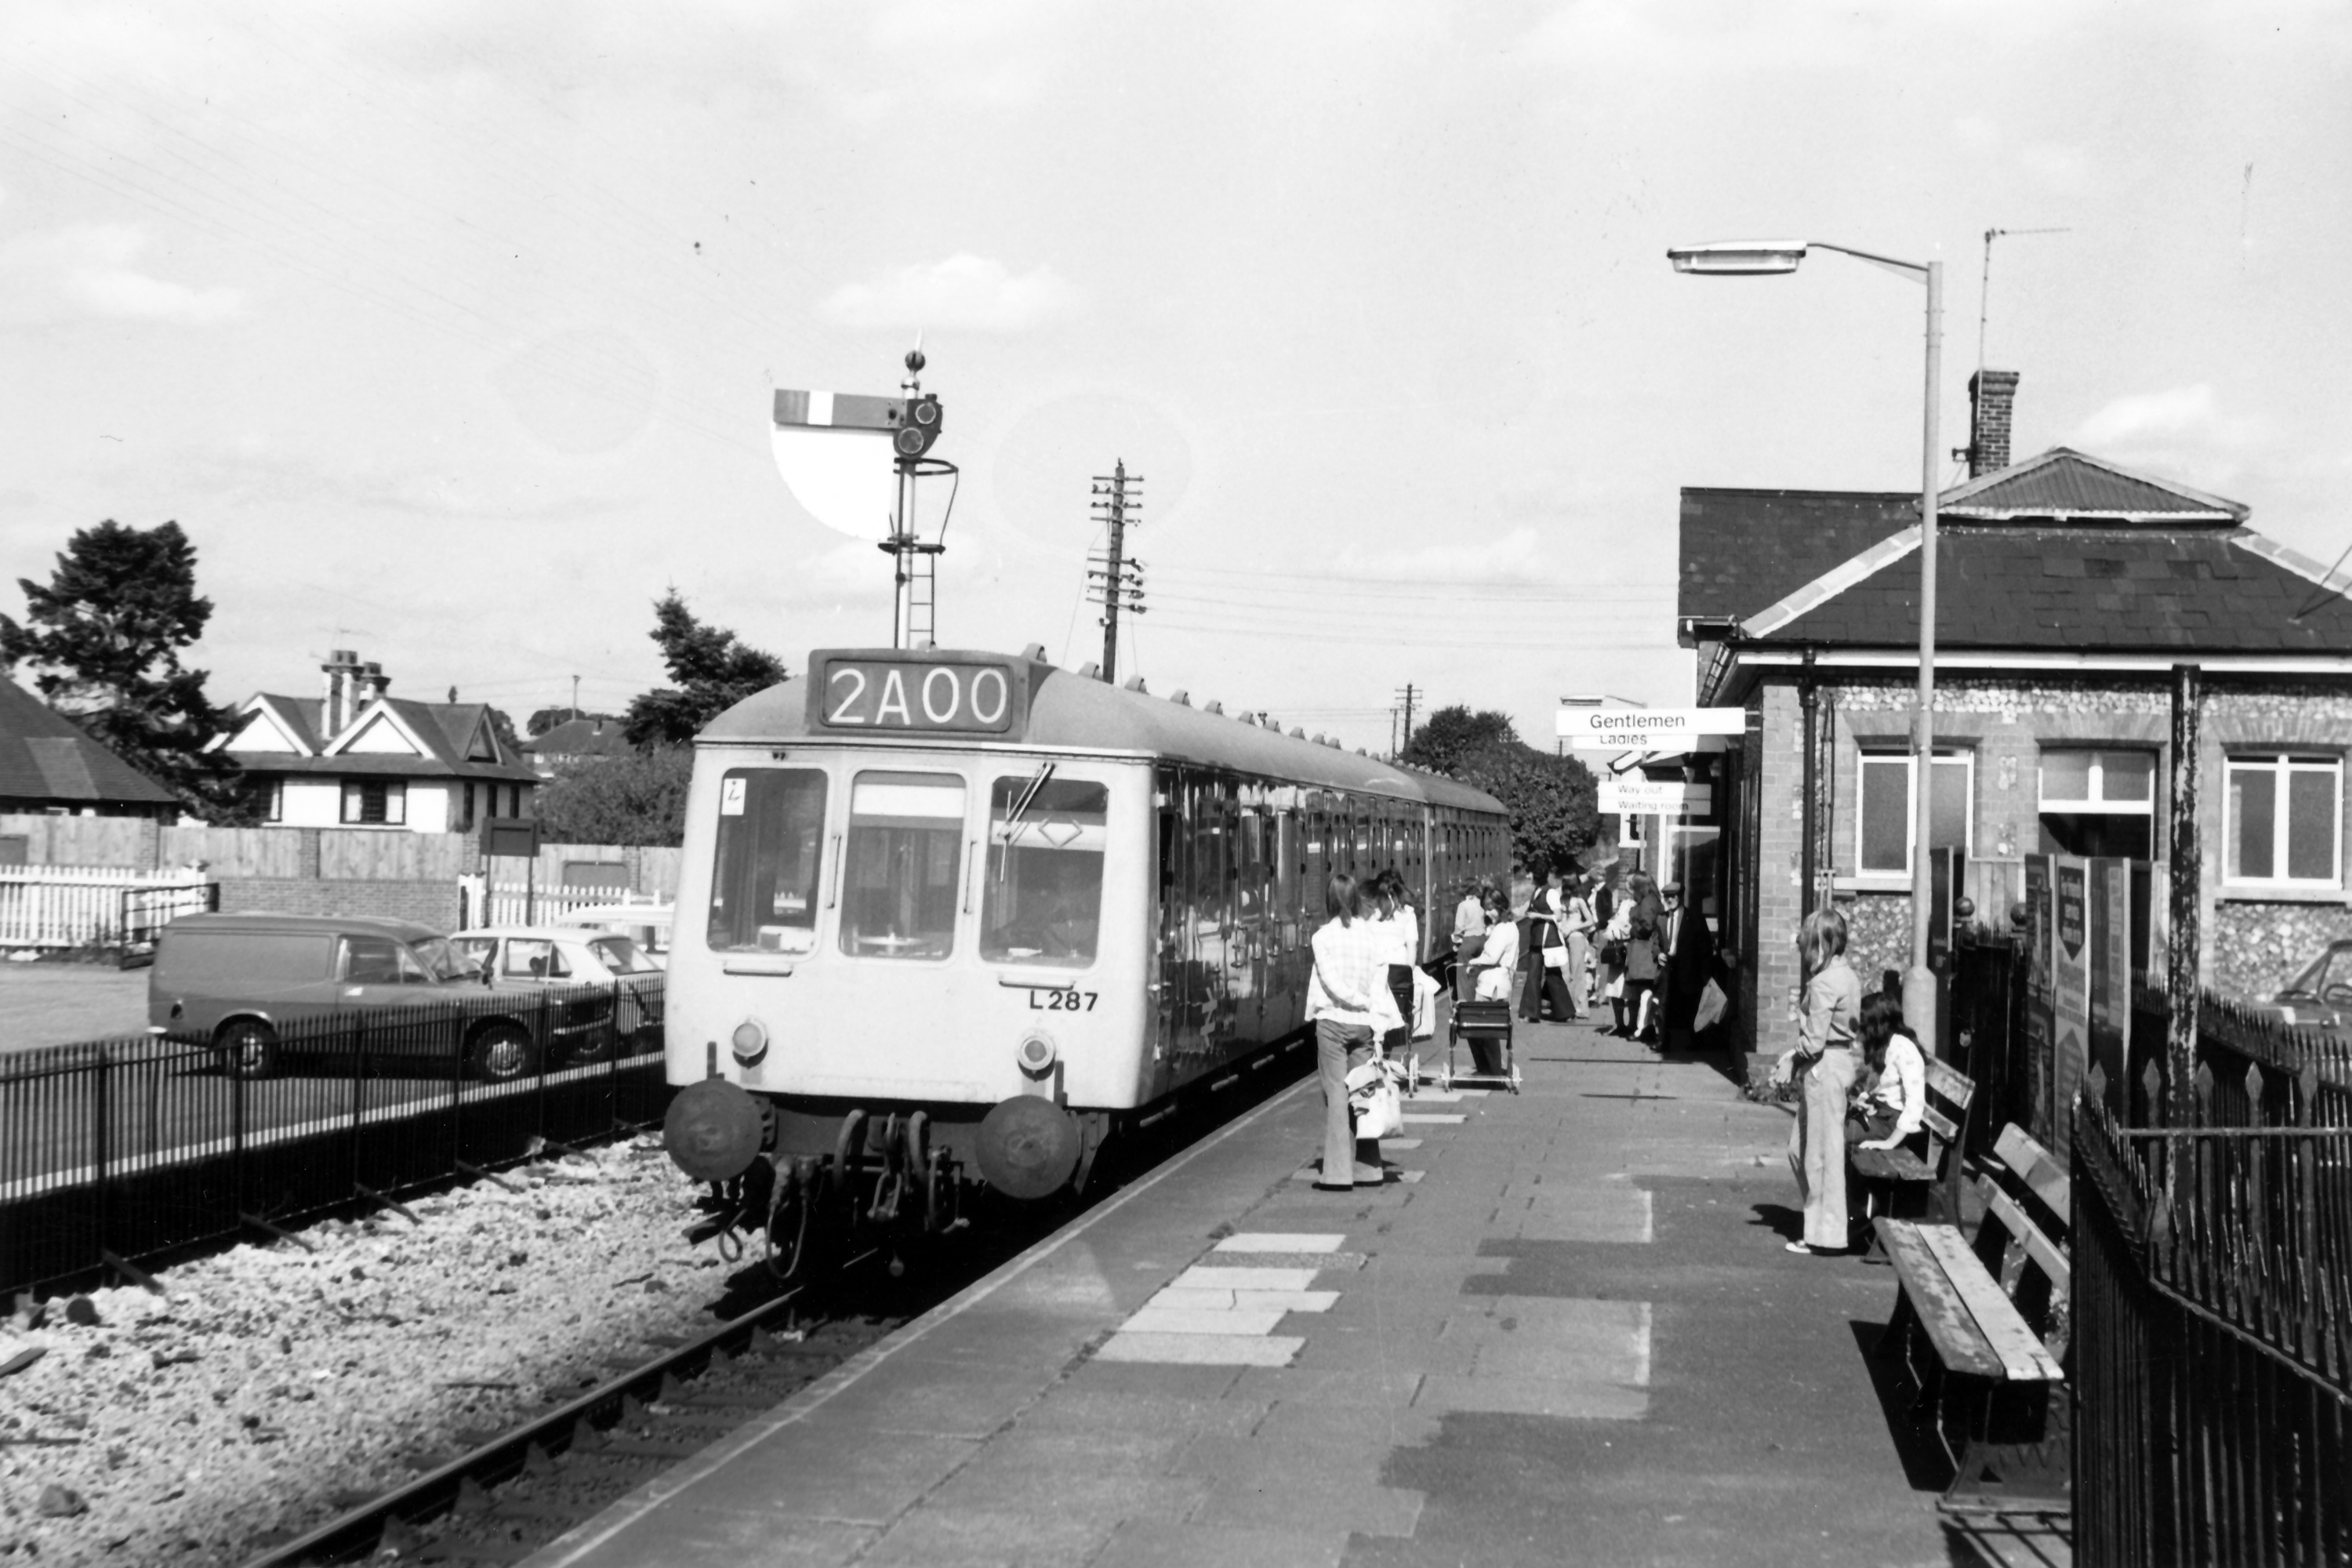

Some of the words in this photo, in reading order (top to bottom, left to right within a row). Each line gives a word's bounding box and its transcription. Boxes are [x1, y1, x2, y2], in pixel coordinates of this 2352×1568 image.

[829, 667, 1007, 725] 2A00
[1590, 713, 1686, 729] Gentlemen
[1599, 734, 1648, 745] Ladies
[1617, 785, 1640, 794] Way
[1644, 786, 1663, 794] out
[1617, 800, 1657, 811] Waiting
[1029, 989, 1098, 1012] L287
